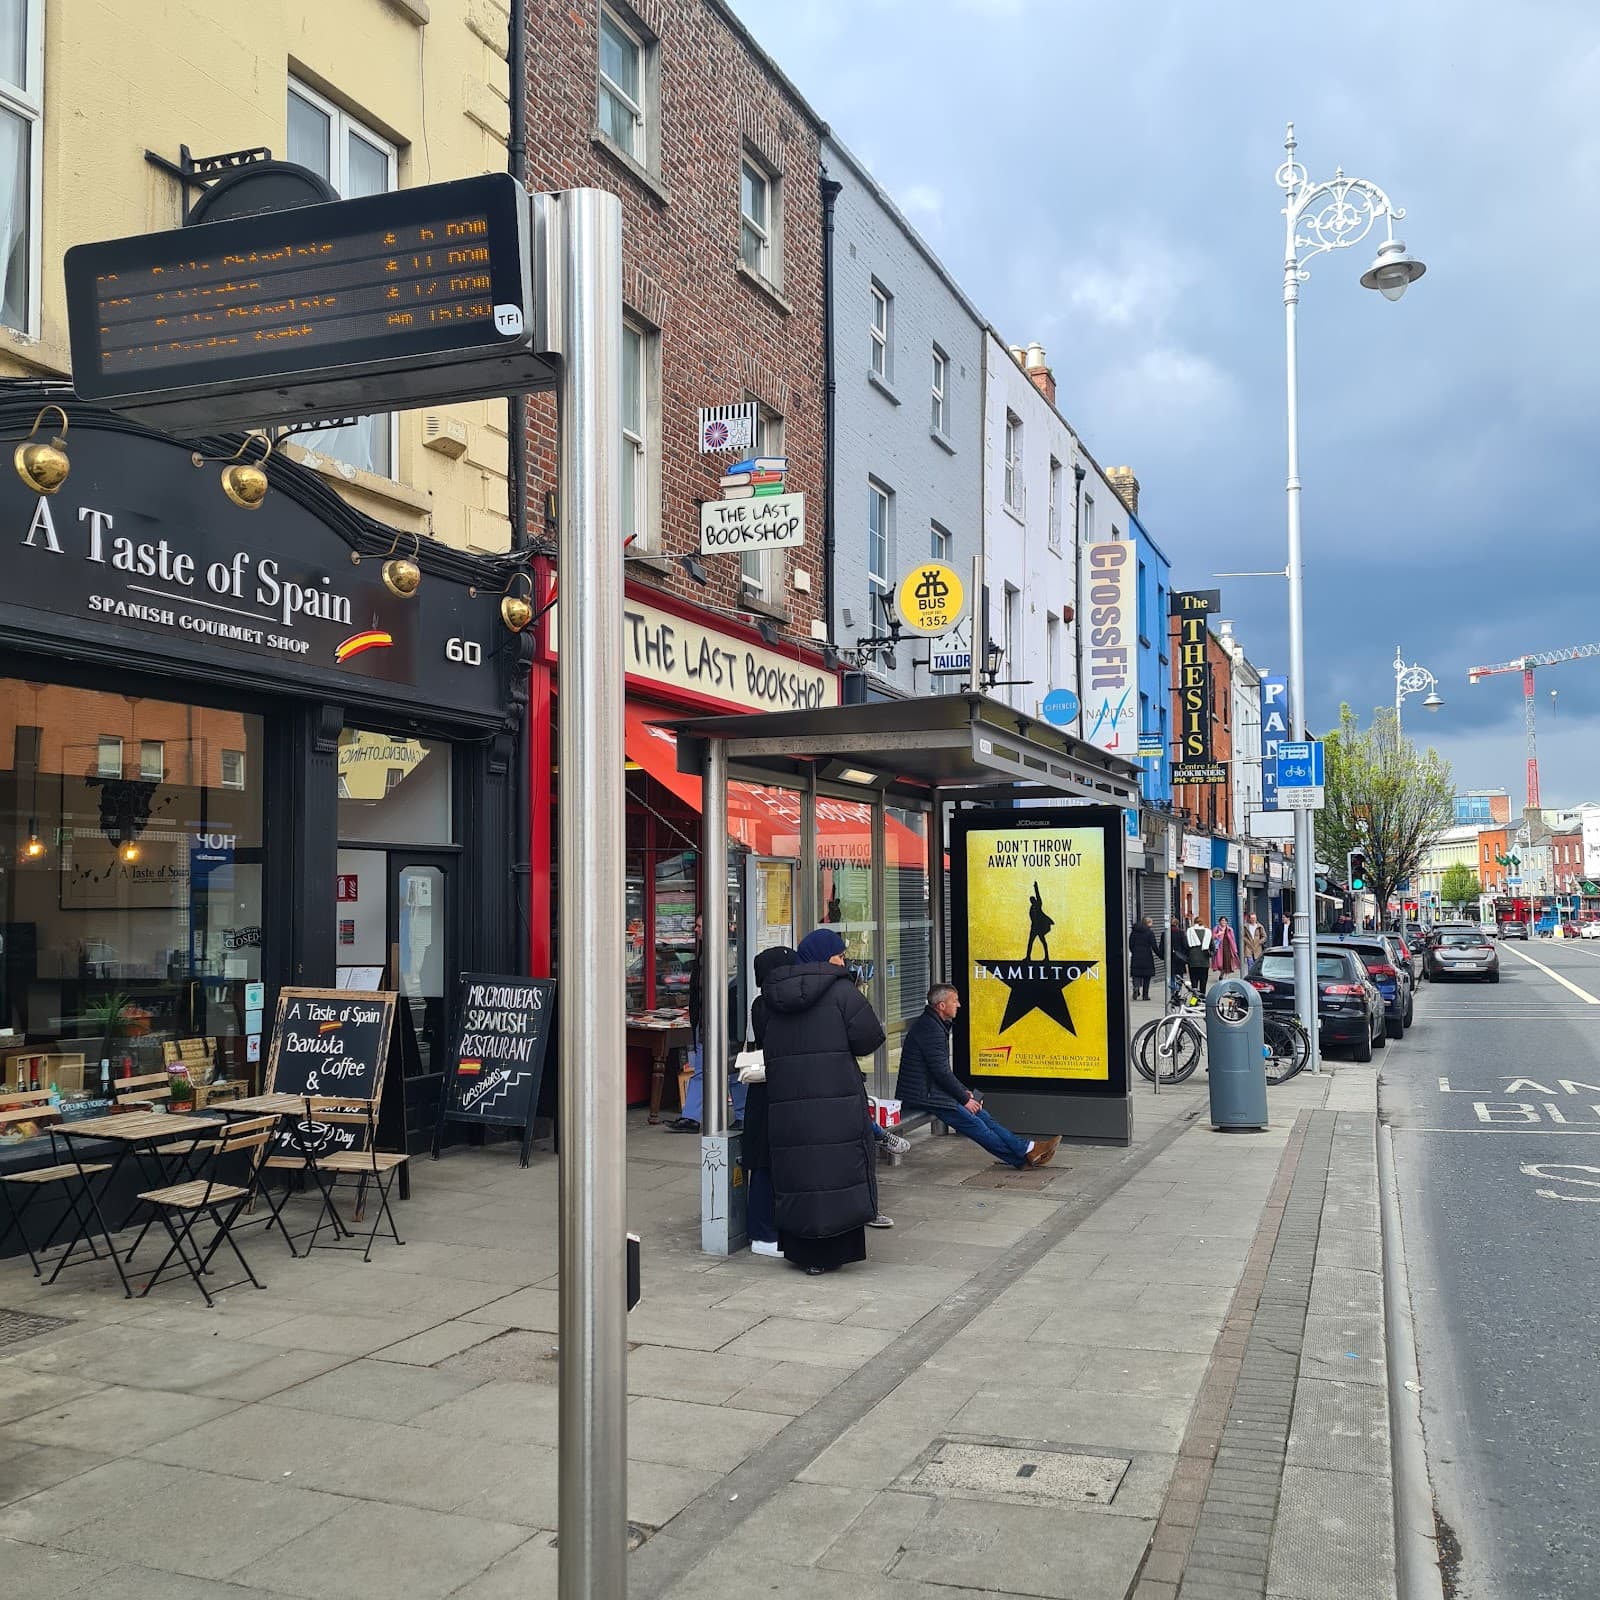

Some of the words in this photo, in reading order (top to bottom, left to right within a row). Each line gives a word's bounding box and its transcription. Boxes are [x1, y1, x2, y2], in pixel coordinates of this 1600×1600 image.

[498, 313, 519, 327] TFI
[714, 507, 747, 524] THE
[753, 503, 790, 520] LAST
[705, 517, 800, 547] BOOKSHOP
[21, 495, 65, 555] A
[79, 507, 195, 586] Taste
[206, 552, 249, 599] of
[256, 559, 352, 627] Spain
[918, 597, 946, 610] BUS
[1181, 595, 1209, 610] The
[88, 595, 175, 628] SPANISH
[178, 614, 263, 645] GOURMET
[266, 633, 311, 655] SHOP
[919, 615, 948, 627] 1352
[446, 637, 482, 667] 60
[624, 610, 675, 673] THE
[684, 636, 737, 691] LAST
[744, 651, 826, 711] BOOKSHOP
[1182, 618, 1206, 757] THESIS
[1174, 769, 1226, 778] BOOKBINDERS
[997, 840, 1029, 853] DON'T
[1033, 839, 1072, 852] THROW
[988, 854, 1018, 868] AWAY
[1022, 854, 1051, 867] YOUR
[1054, 853, 1082, 867] SHOT
[225, 932, 260, 949] CLOSED
[974, 965, 1100, 981] HAMILTON
[288, 1003, 301, 1020] A
[306, 1003, 337, 1022] Taste
[340, 1006, 352, 1022] of
[351, 1006, 380, 1027] Spain
[464, 1009, 528, 1034] SPANISH
[286, 1032, 344, 1055] Barista
[459, 1033, 538, 1063] RESTAURANT
[321, 1057, 365, 1080] Coffee
[306, 1070, 320, 1090] &
[462, 1067, 501, 1106] UPSTAIRS
[335, 1128, 356, 1150] Day
